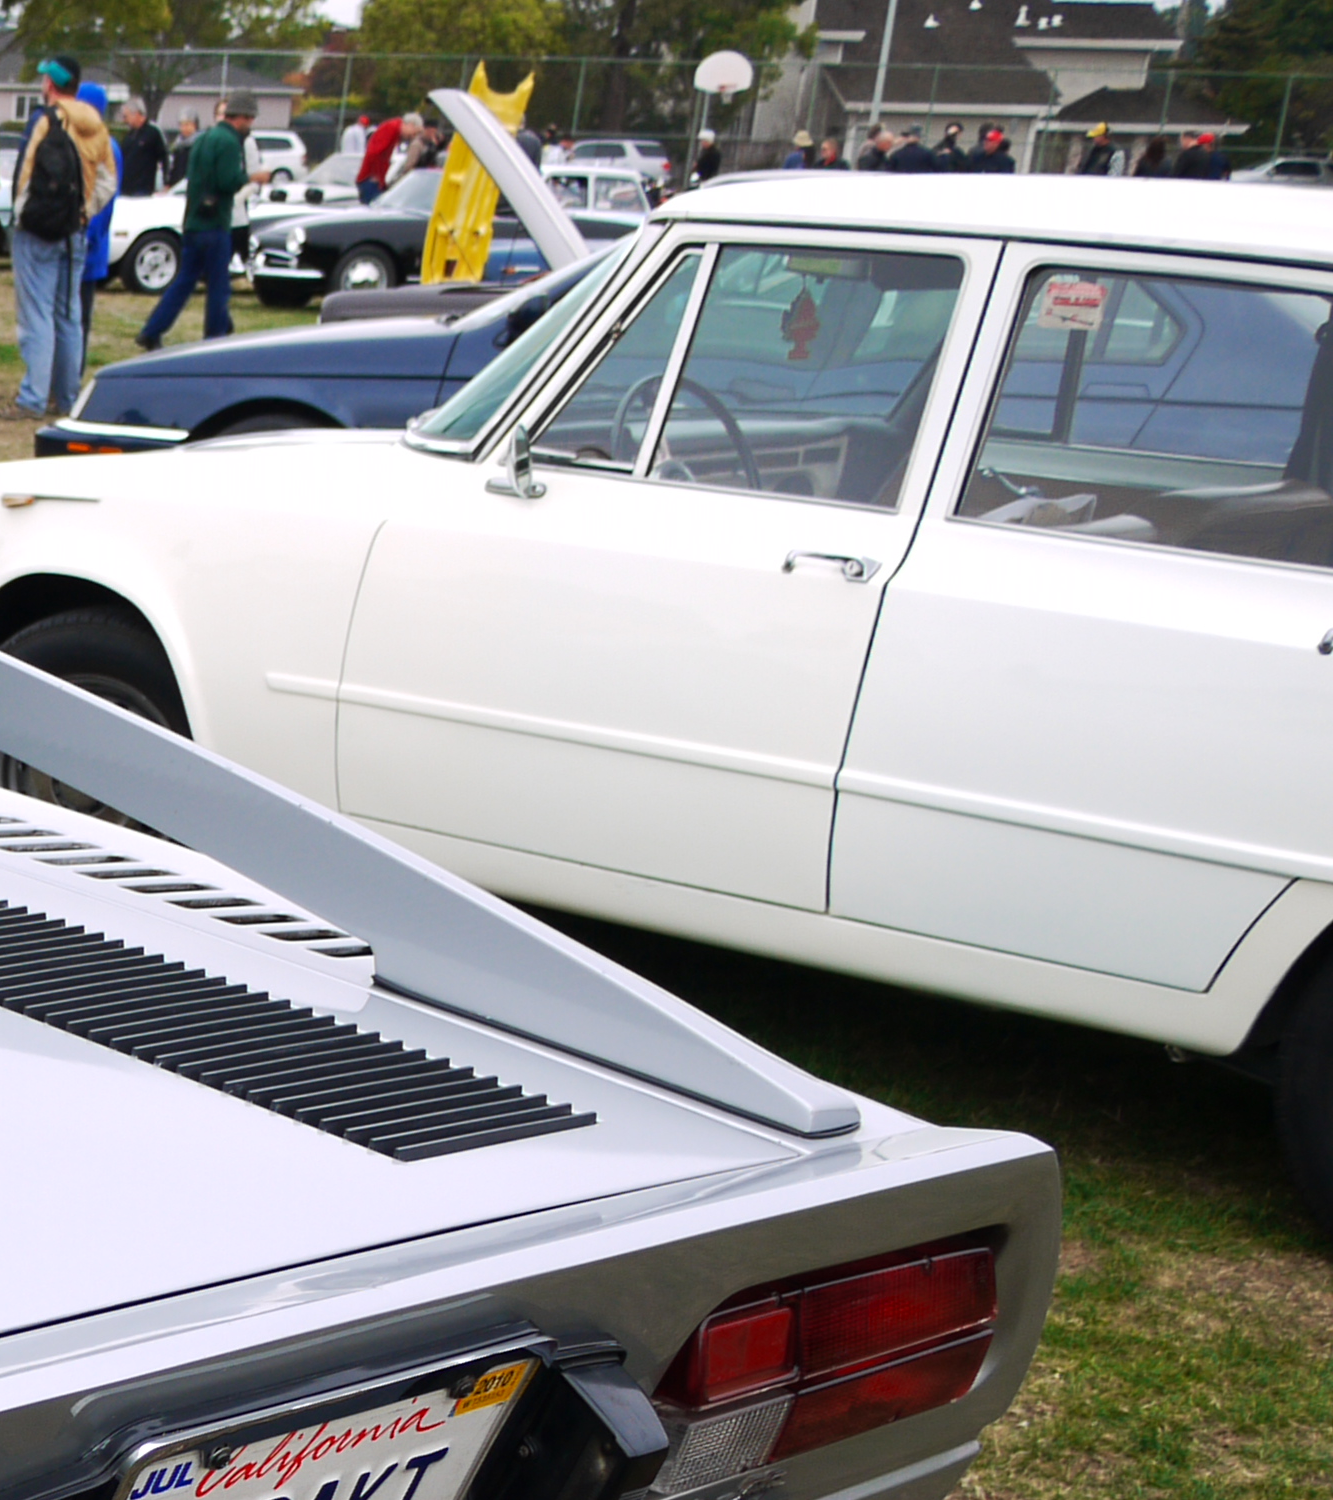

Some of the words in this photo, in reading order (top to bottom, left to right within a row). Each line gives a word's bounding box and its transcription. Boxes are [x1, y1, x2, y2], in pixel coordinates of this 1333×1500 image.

[473, 1369, 515, 1396] 2010
[129, 1462, 195, 1500] JUL
[194, 1396, 447, 1498] California
